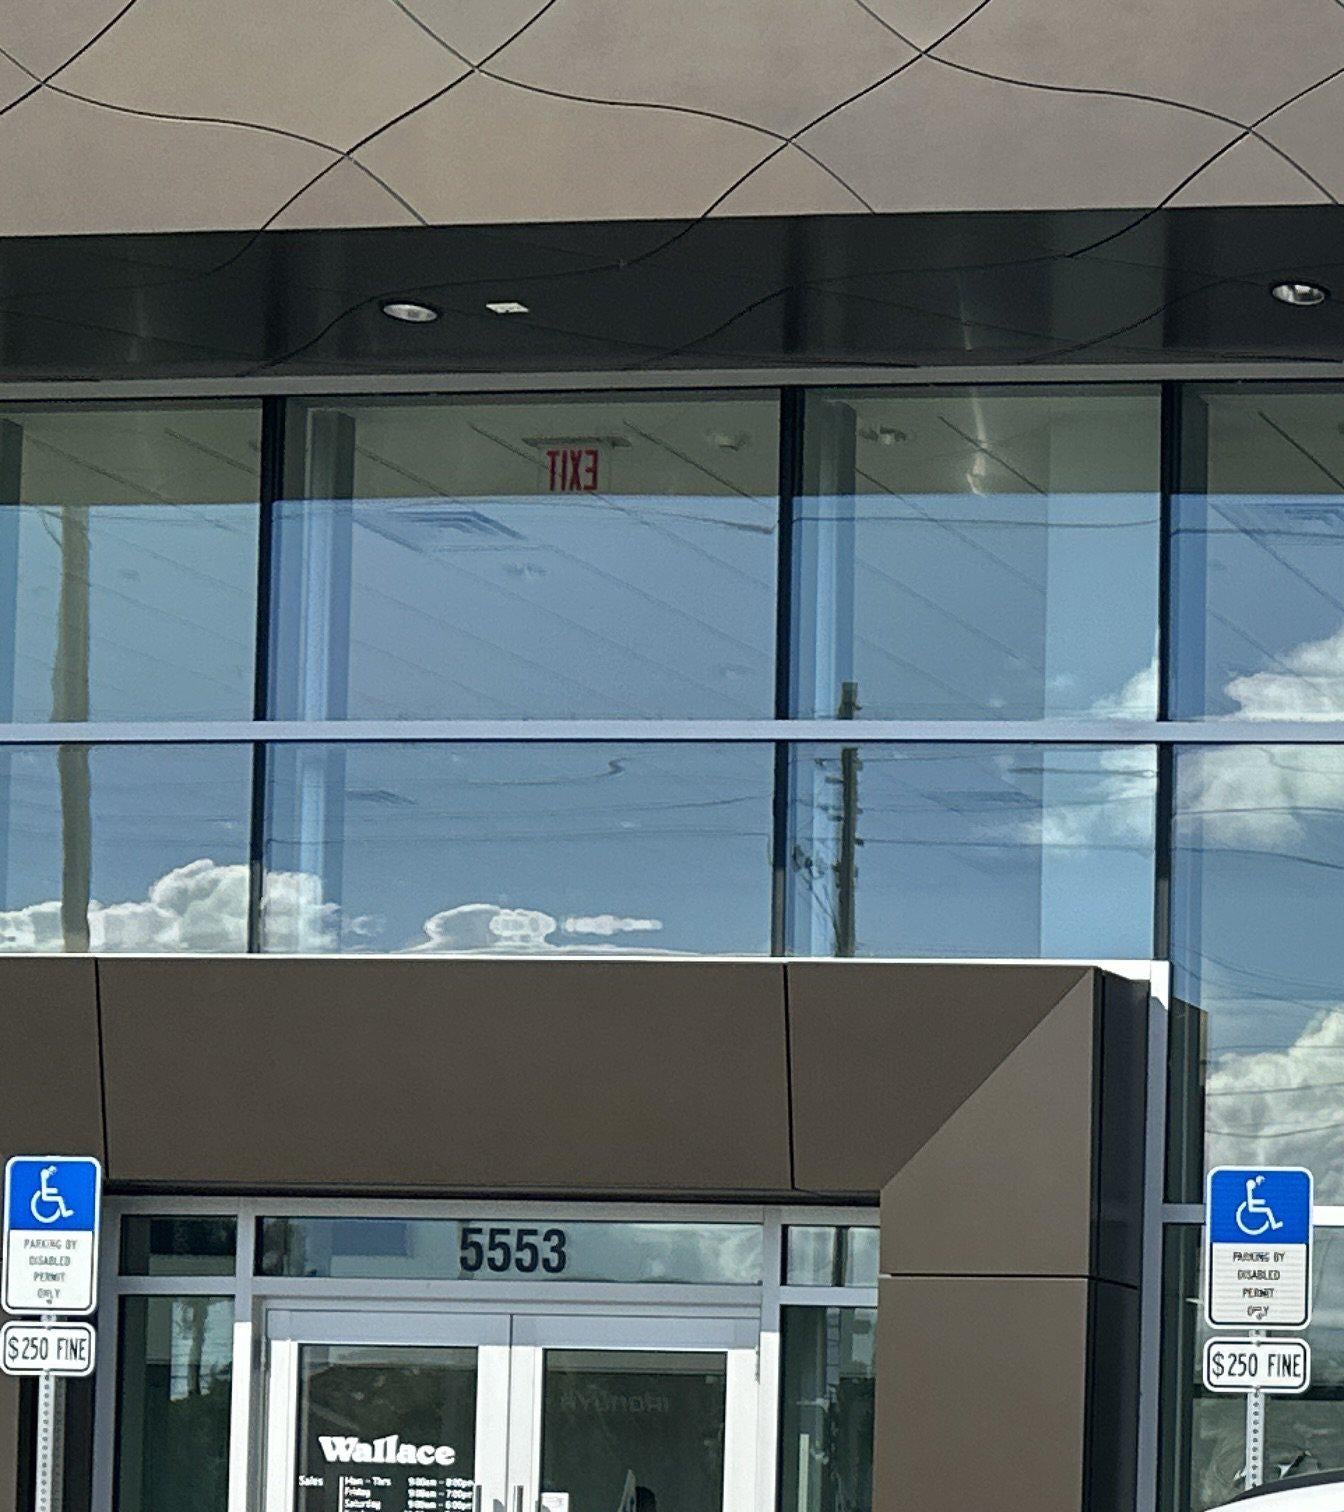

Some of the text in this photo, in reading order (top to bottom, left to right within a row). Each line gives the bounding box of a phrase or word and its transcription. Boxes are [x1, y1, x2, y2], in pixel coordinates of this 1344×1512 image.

[24, 1238, 78, 1250] PARKING BY
[460, 1227, 567, 1273] 5553
[29, 1255, 71, 1266] DISABLED
[1232, 1252, 1285, 1263] PARKING BY
[33, 1272, 66, 1282] PERMIT
[1237, 1270, 1281, 1281] DISABLED
[1242, 1288, 1274, 1298] PERMIT
[8, 1337, 87, 1362] $250 FINE
[1212, 1351, 1301, 1378] $250 FINE
[318, 1434, 456, 1466] Wallace
[299, 1475, 324, 1487] Sales
[344, 1498, 382, 1511] Saturday
